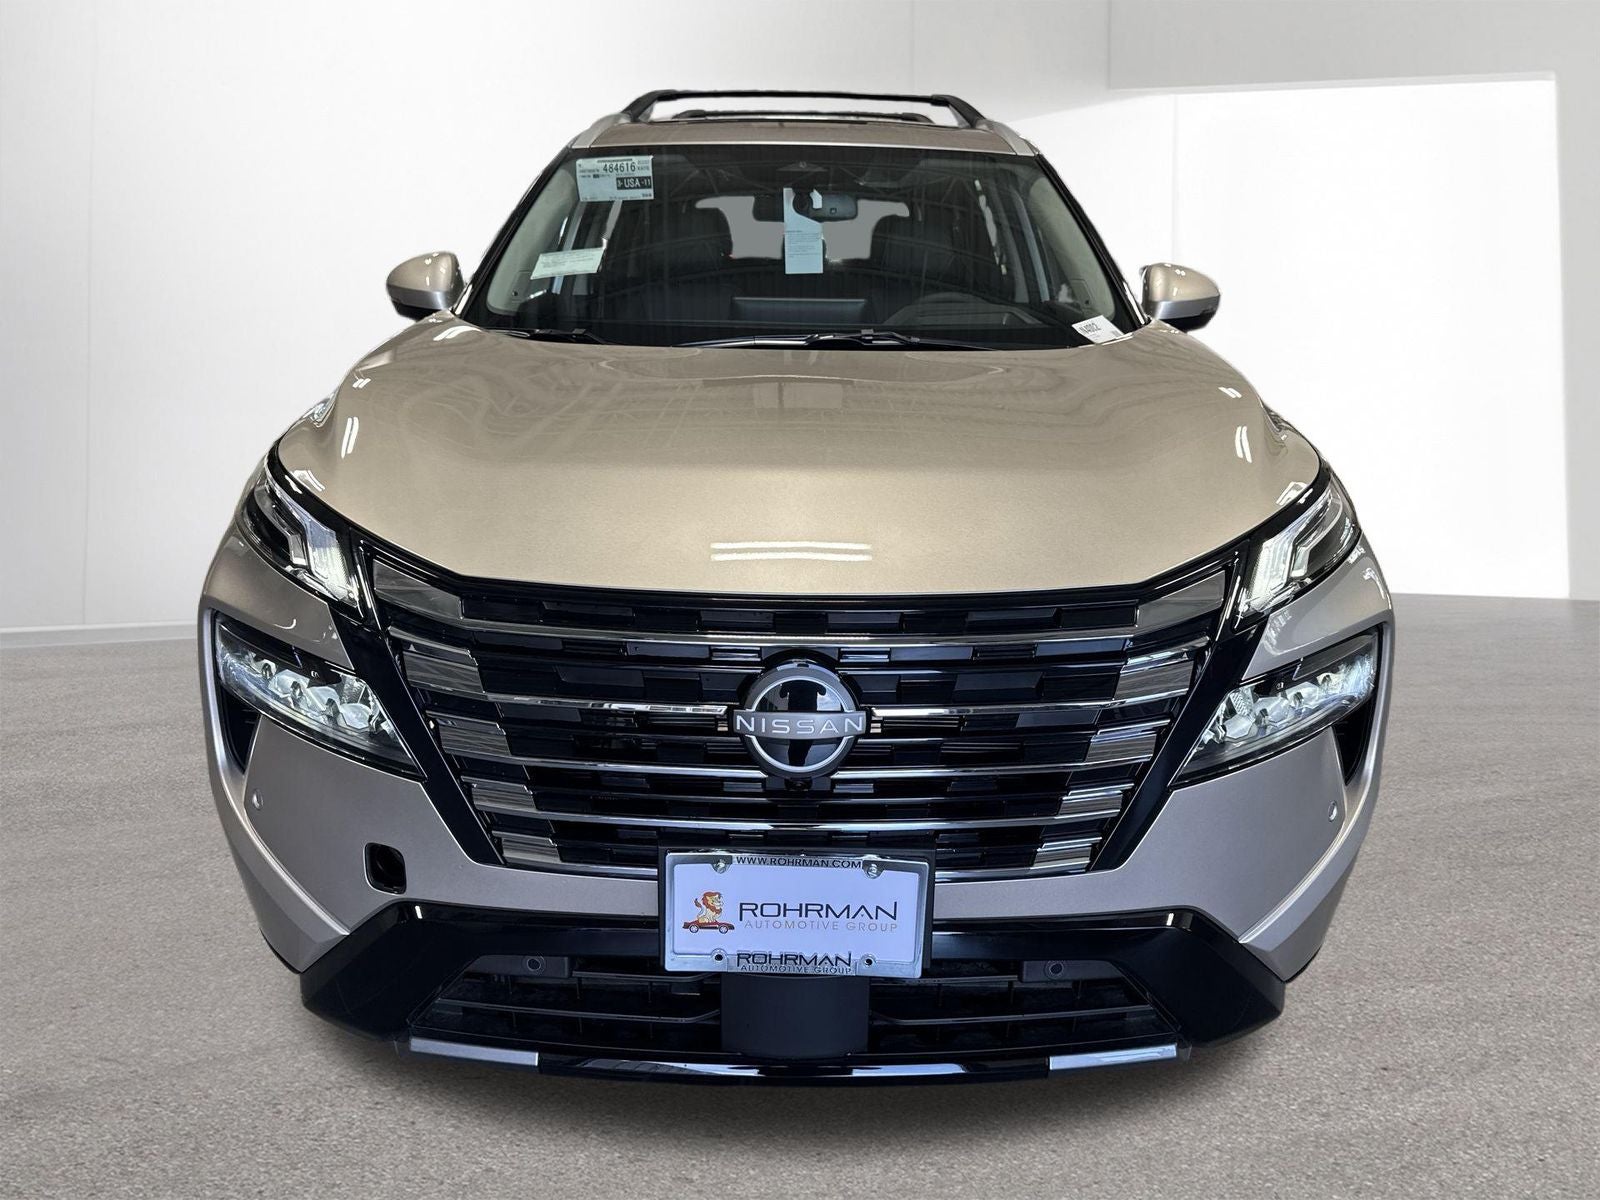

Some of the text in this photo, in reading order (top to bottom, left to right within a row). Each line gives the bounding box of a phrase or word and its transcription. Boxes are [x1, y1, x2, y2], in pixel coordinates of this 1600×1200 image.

[602, 161, 636, 173] 484616
[624, 178, 641, 188] USA
[736, 715, 863, 734] NISSAN
[736, 855, 862, 869] WWW.ROHRMAN.COM
[739, 901, 898, 921] ROHRMAN
[744, 919, 898, 932] AUTOMOTIVE GROUP
[736, 949, 852, 968] ROHRMAN
[740, 964, 852, 975] AUTOMOTIVE GROUP
